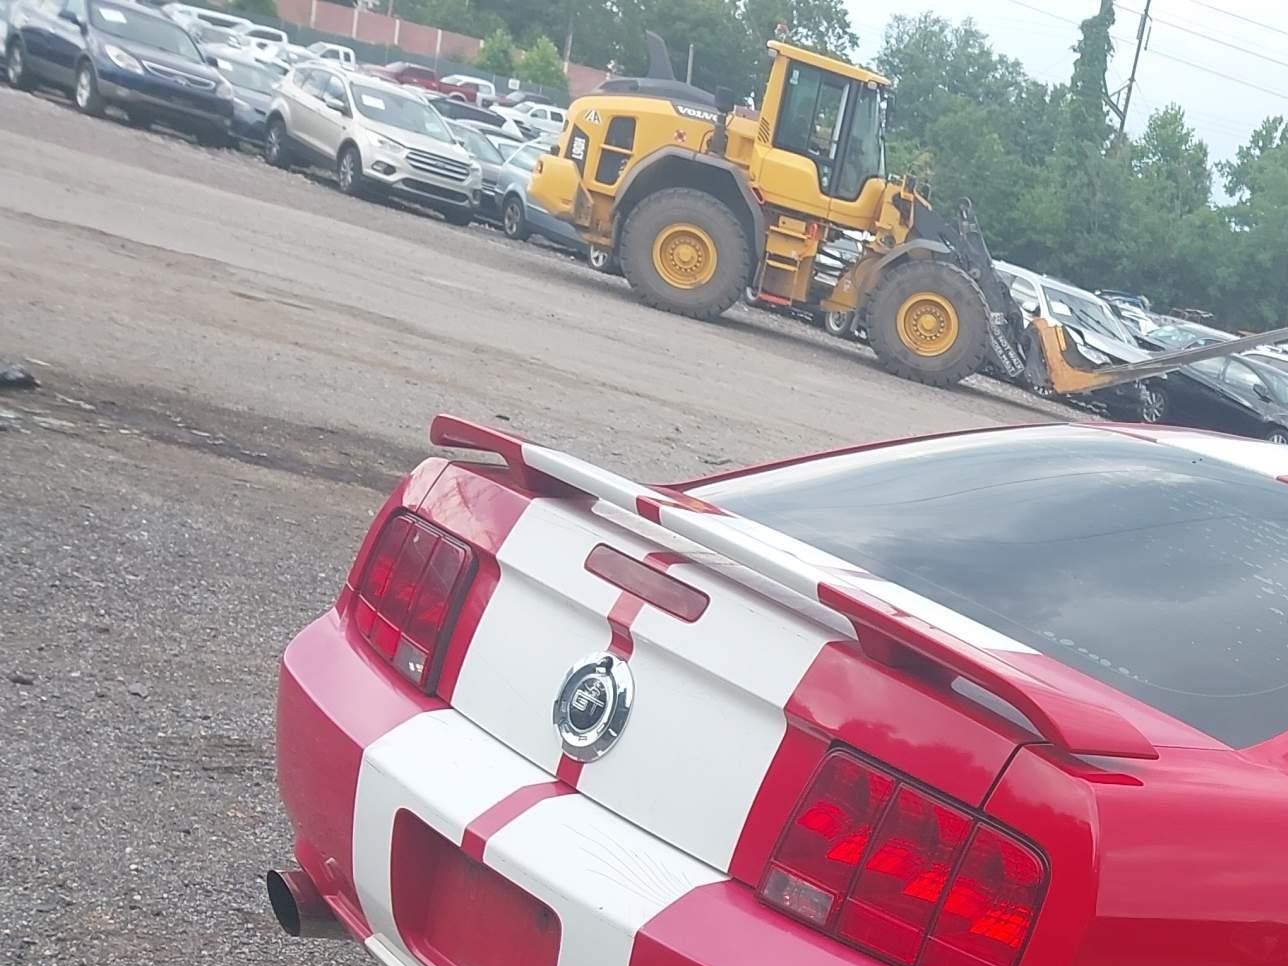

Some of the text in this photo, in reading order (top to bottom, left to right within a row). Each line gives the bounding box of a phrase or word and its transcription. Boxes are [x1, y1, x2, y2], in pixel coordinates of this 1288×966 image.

[677, 105, 718, 122] VOLVO
[997, 336, 1010, 351] NOT
[1008, 351, 1023, 369] WALK
[1001, 355, 1016, 372] MAST
[572, 689, 605, 716] GT
